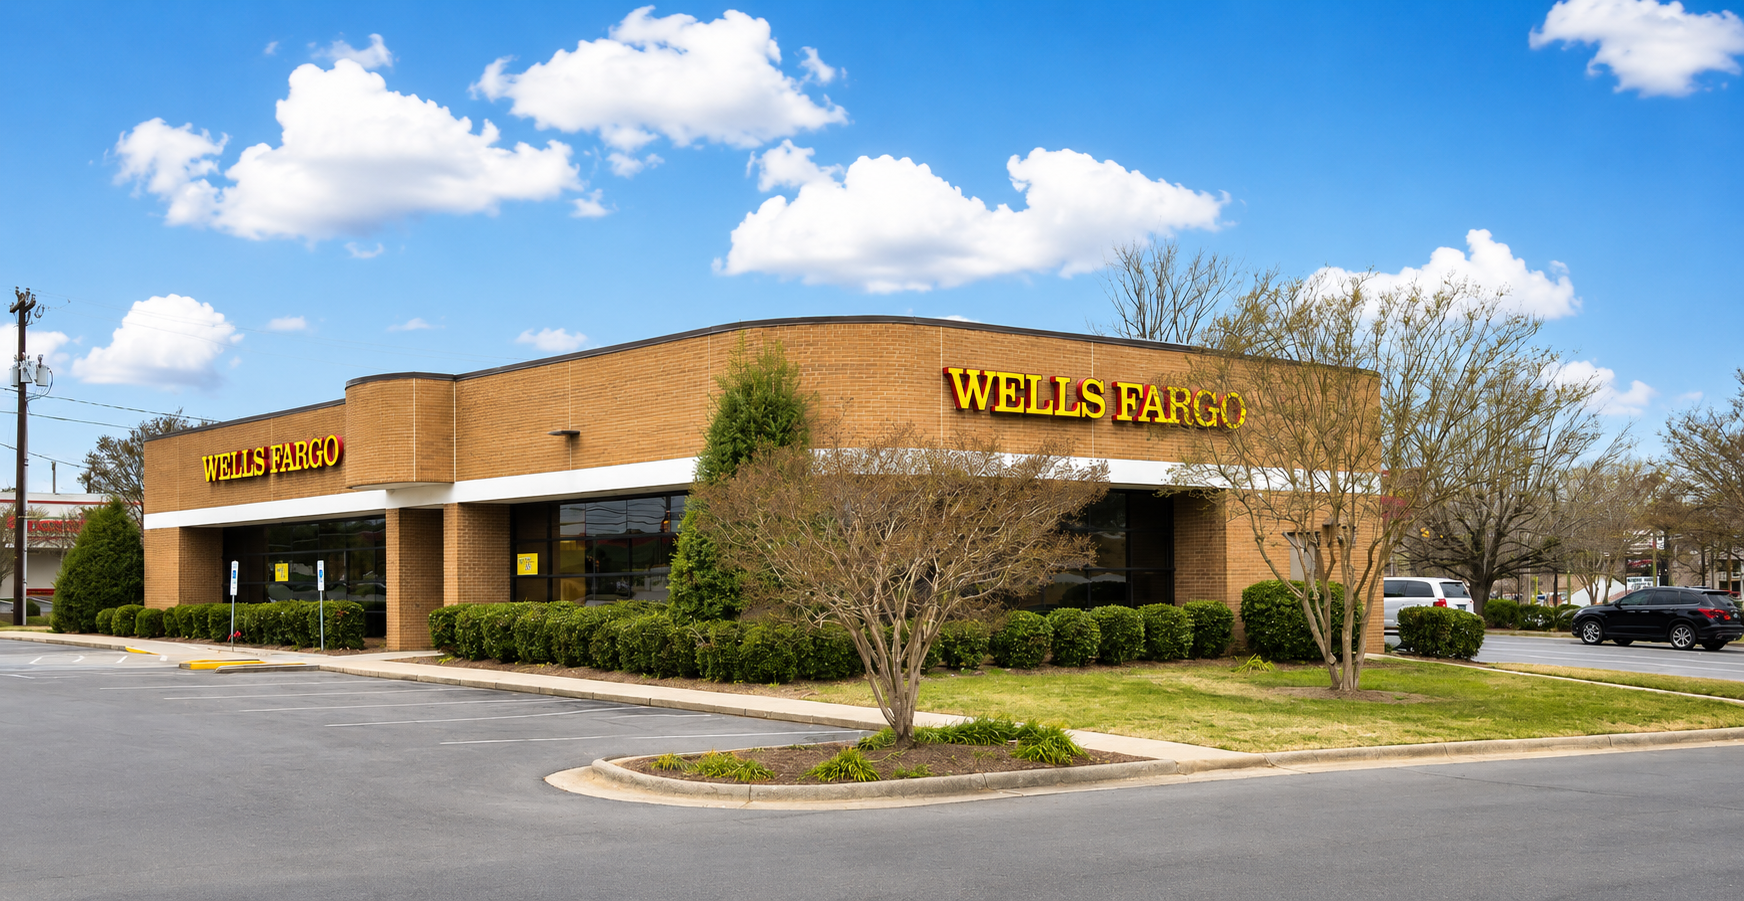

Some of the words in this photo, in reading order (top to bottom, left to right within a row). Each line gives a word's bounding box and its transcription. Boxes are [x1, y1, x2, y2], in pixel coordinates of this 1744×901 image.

[943, 366, 1106, 419] WELLS
[1112, 381, 1247, 429] FARGO
[201, 446, 267, 482] WELLS
[269, 434, 343, 474] FARGO
